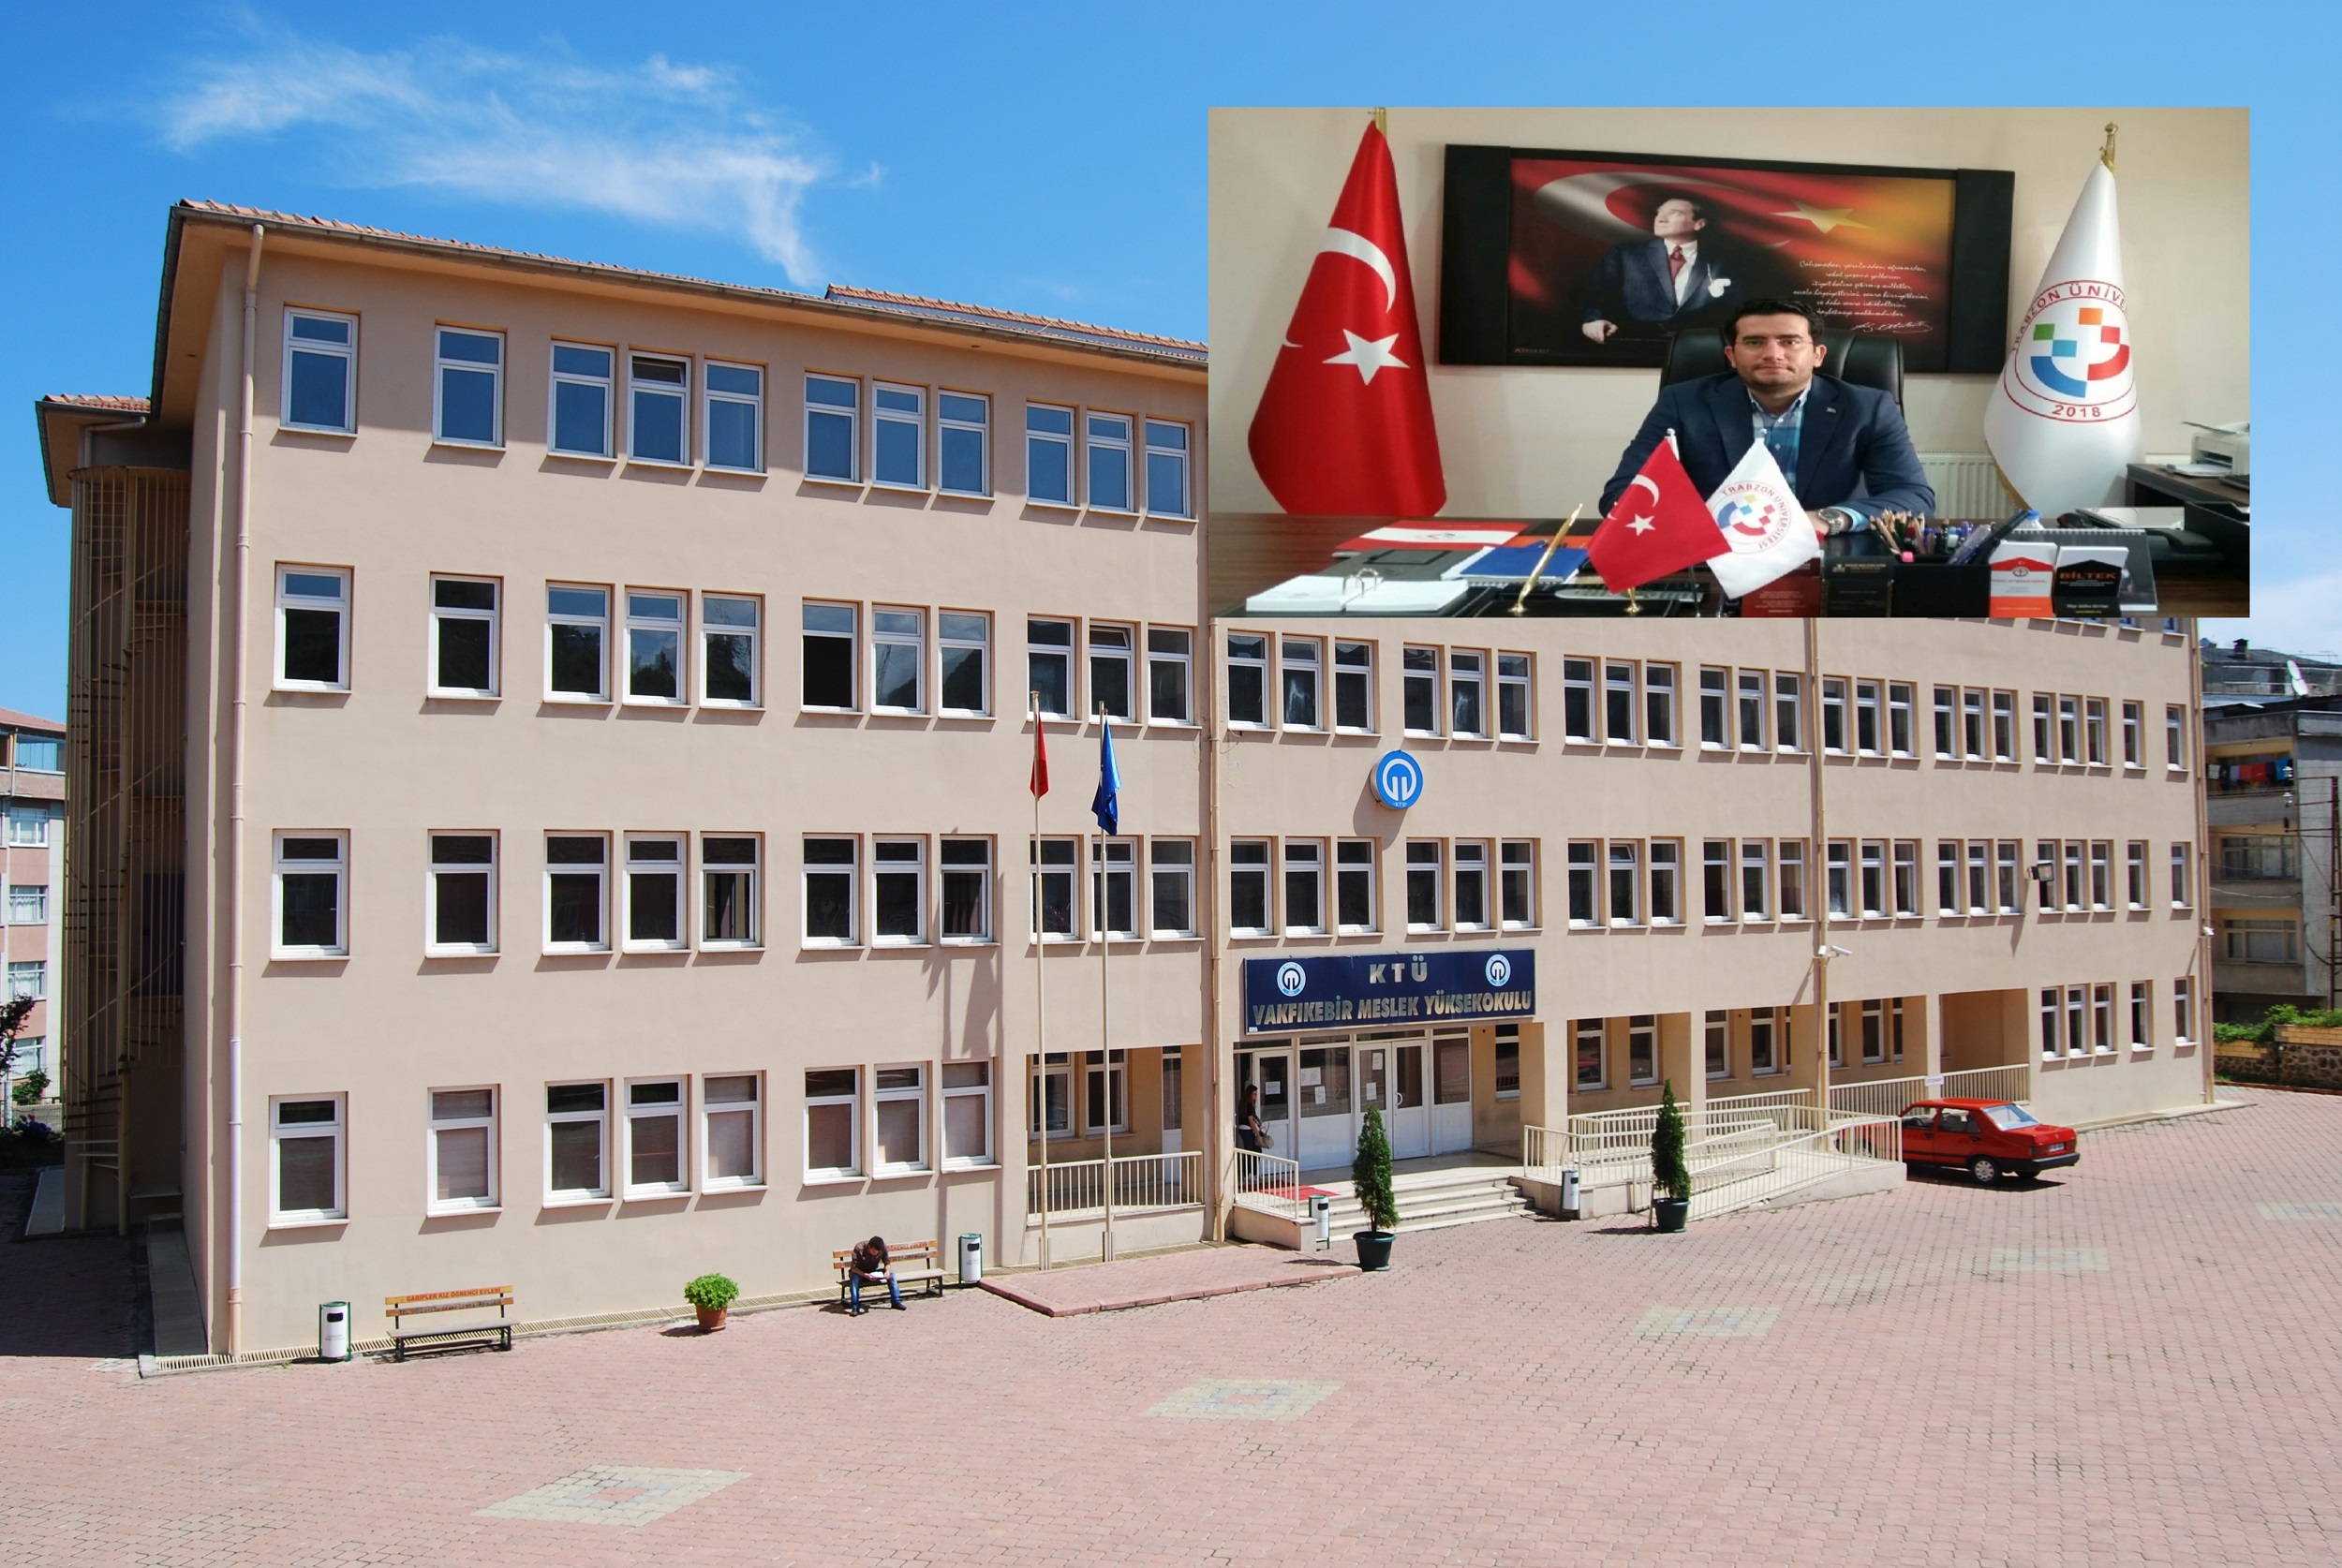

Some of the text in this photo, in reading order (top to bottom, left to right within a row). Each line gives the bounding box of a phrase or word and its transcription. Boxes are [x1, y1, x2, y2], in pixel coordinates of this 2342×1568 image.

[2052, 404, 2101, 418] 2018
[1722, 483, 1775, 496] TRABZON
[1369, 955, 1428, 984] KTÜ
[1253, 989, 1532, 1026] VAKFIKEBİR MESLEK YÜKSEKOKULU
